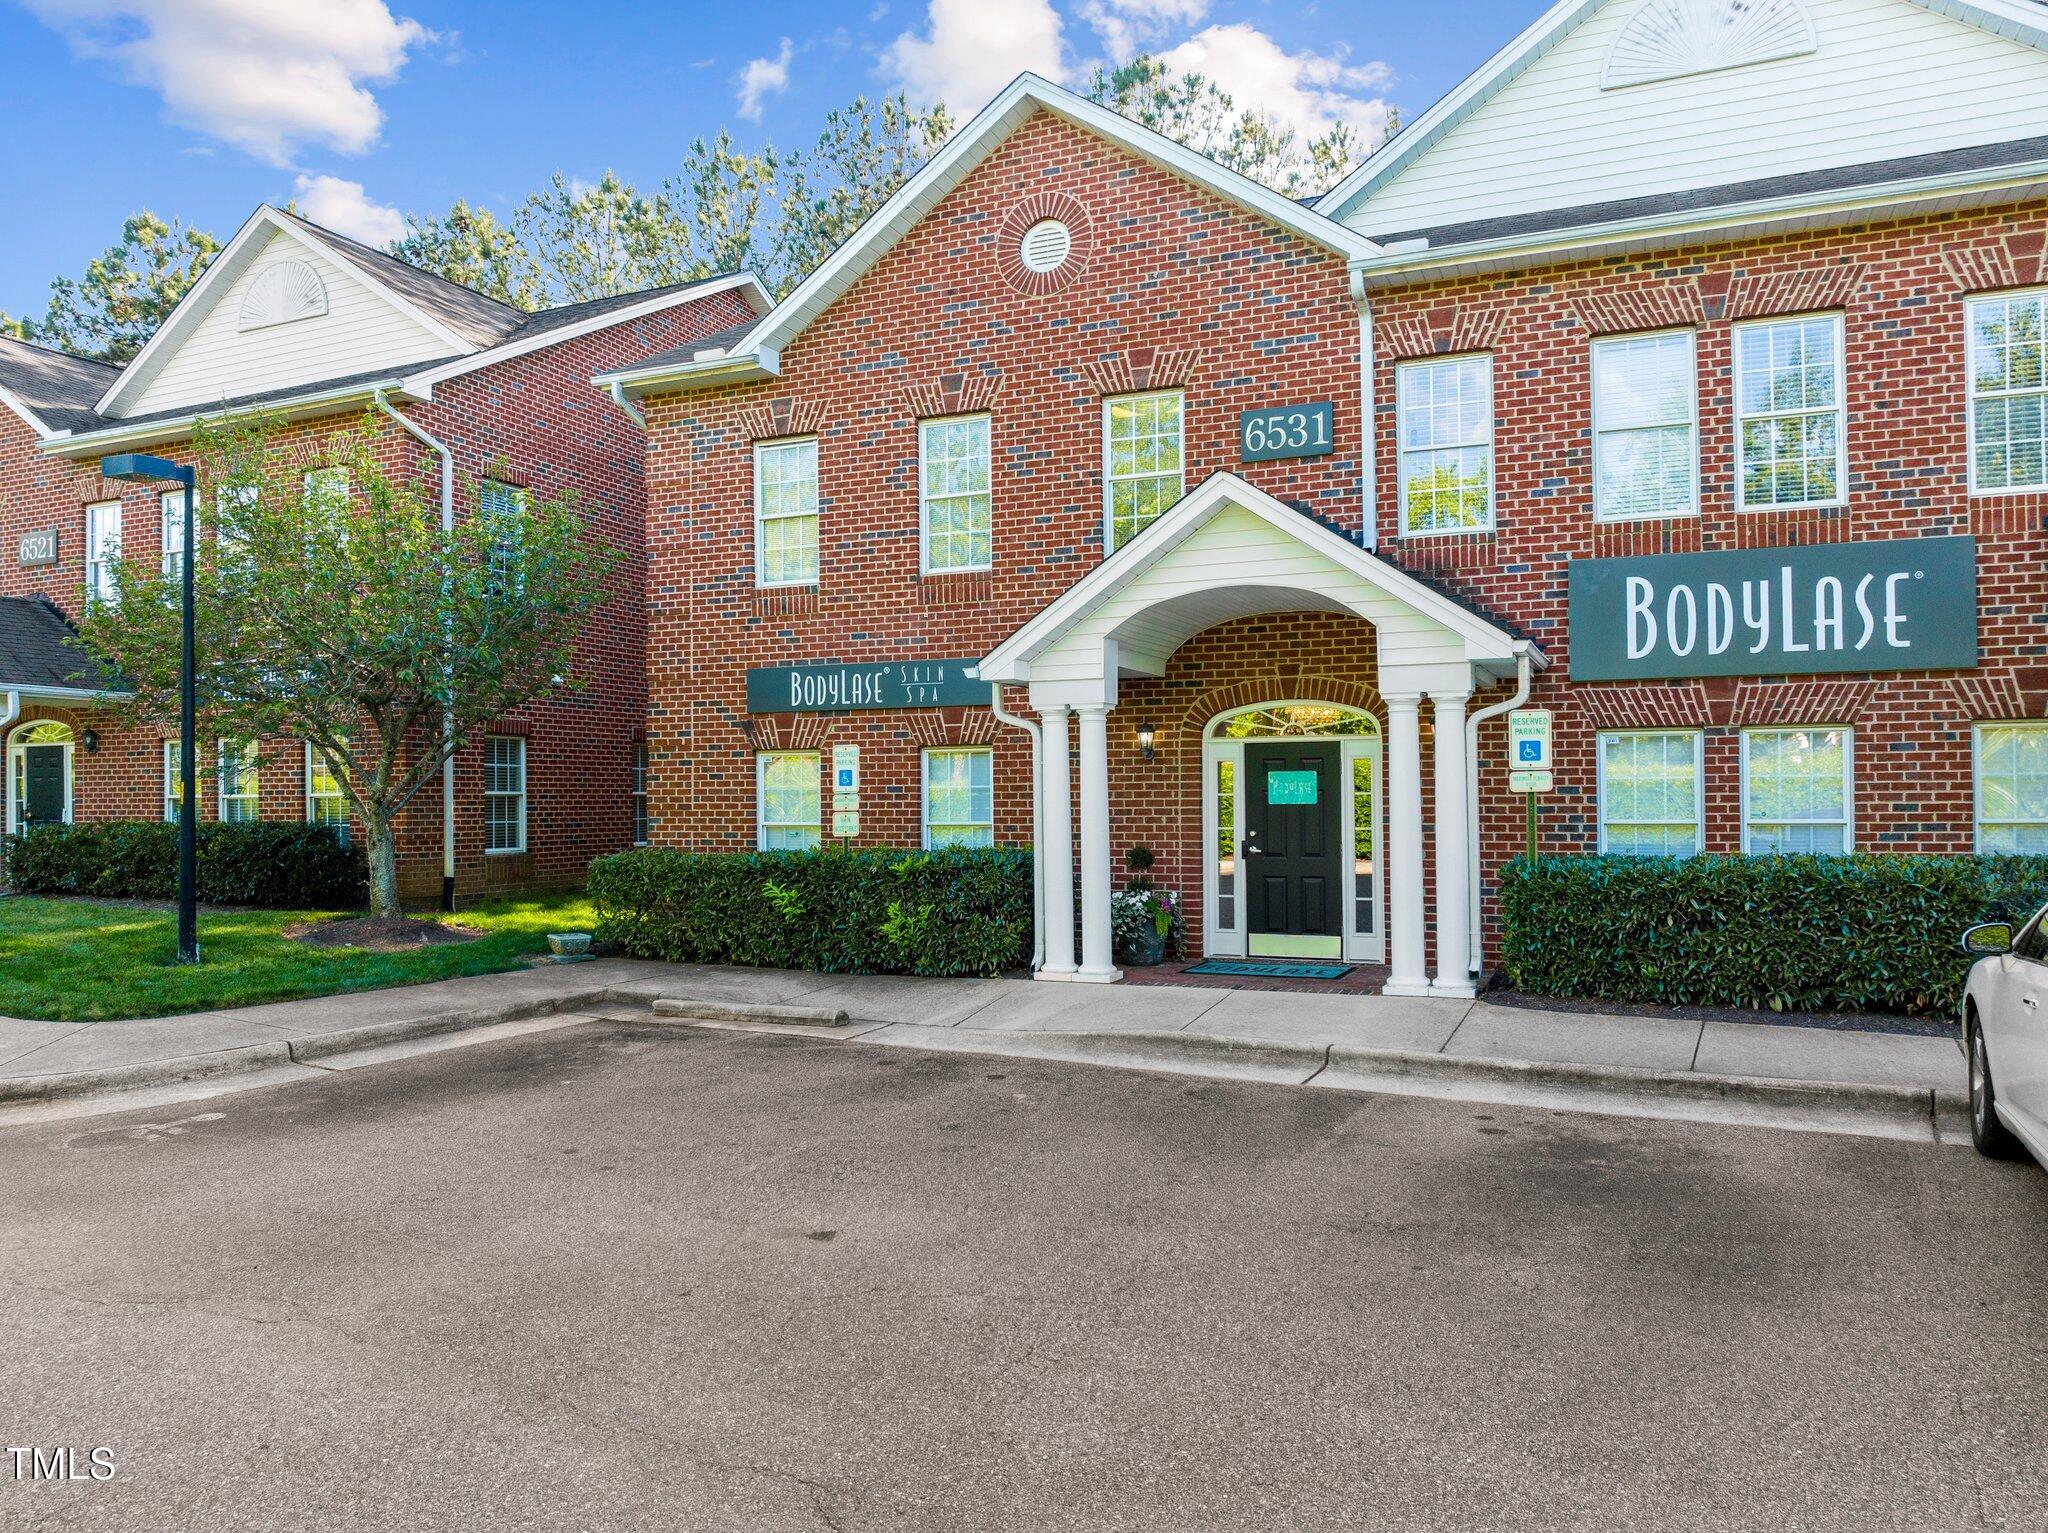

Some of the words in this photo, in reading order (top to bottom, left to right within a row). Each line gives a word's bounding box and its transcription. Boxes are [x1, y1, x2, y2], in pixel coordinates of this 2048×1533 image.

[1245, 411, 1329, 451] 6531
[20, 535, 56, 560] 6521
[901, 666, 944, 683] SKIN
[906, 686, 938, 703] SPA
[1512, 717, 1548, 726] RESERVED
